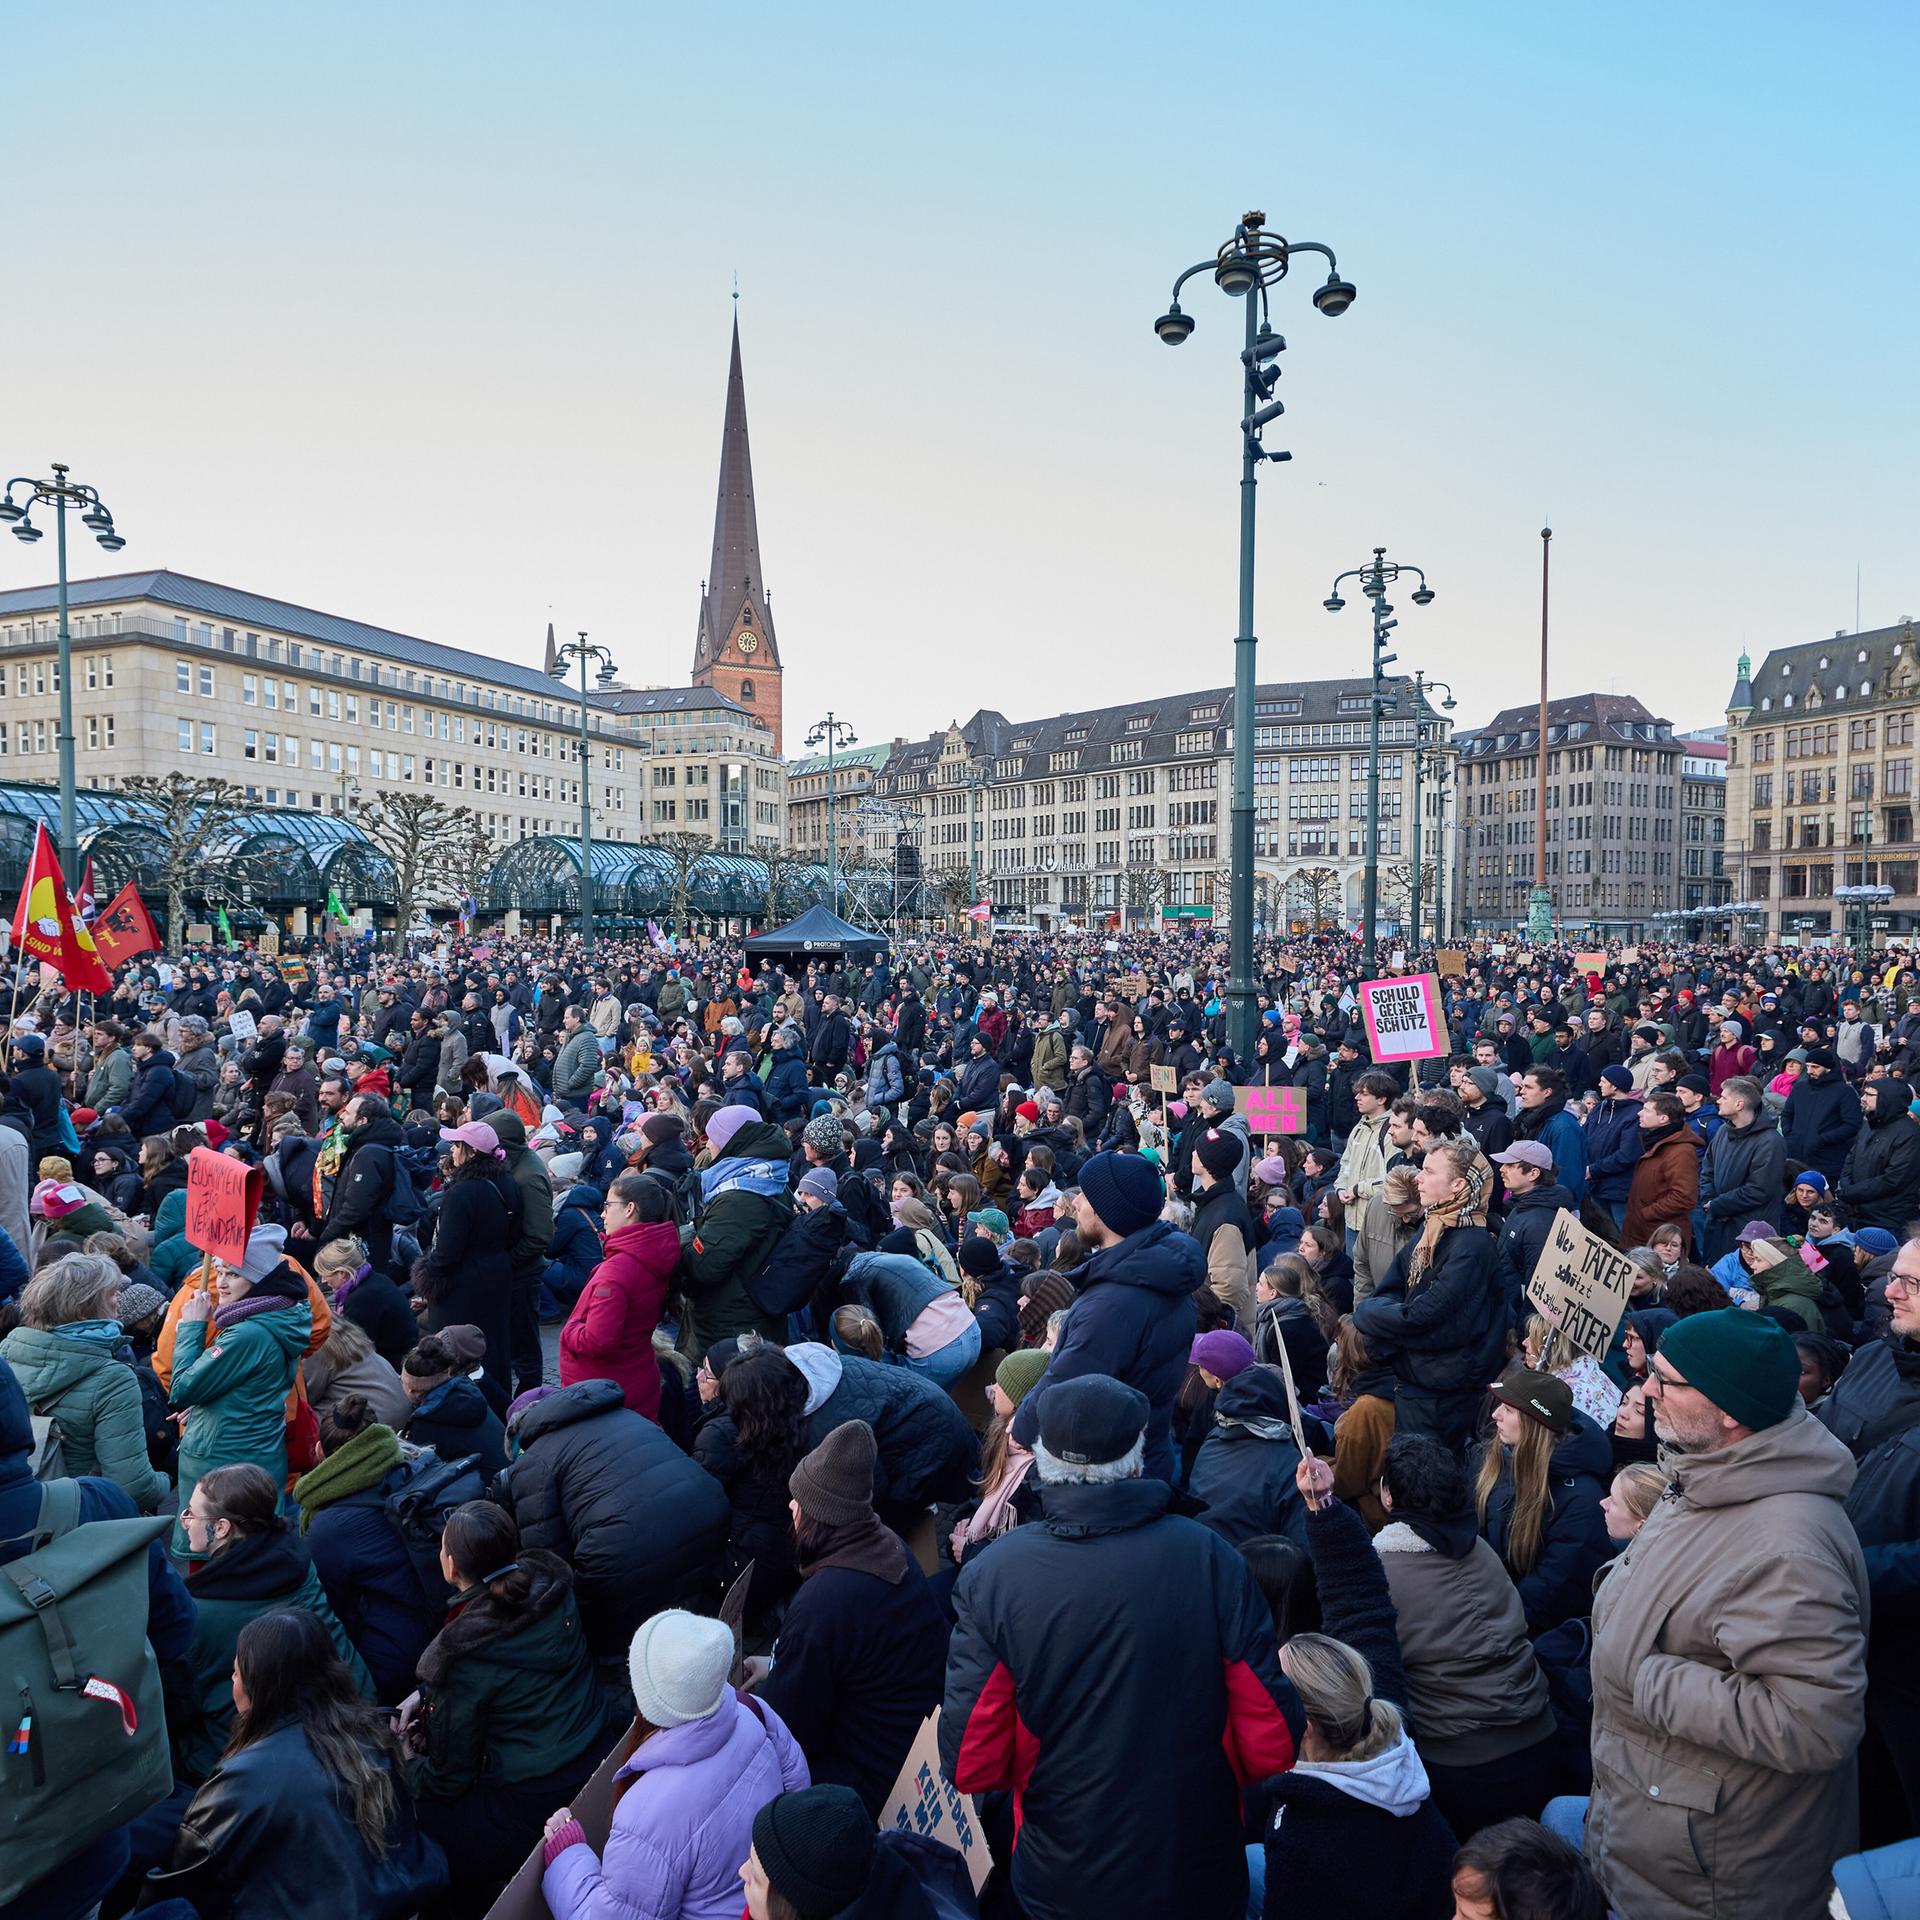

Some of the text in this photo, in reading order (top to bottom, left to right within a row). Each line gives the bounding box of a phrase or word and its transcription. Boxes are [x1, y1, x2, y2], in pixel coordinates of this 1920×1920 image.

[25, 936, 51, 953] SIND
[1371, 985, 1420, 1004] SCHULD
[1378, 1000, 1418, 1017] GEGEN
[1376, 1013, 1427, 1033] SCHUTZ
[1246, 1088, 1301, 1112] ALL
[1247, 1114, 1297, 1134] MEN
[1555, 1219, 1633, 1300] Wer TÄTER
[1554, 1263, 1593, 1300] schützt
[1532, 1275, 1546, 1301] ist
[1560, 1296, 1612, 1361] TÄTER
